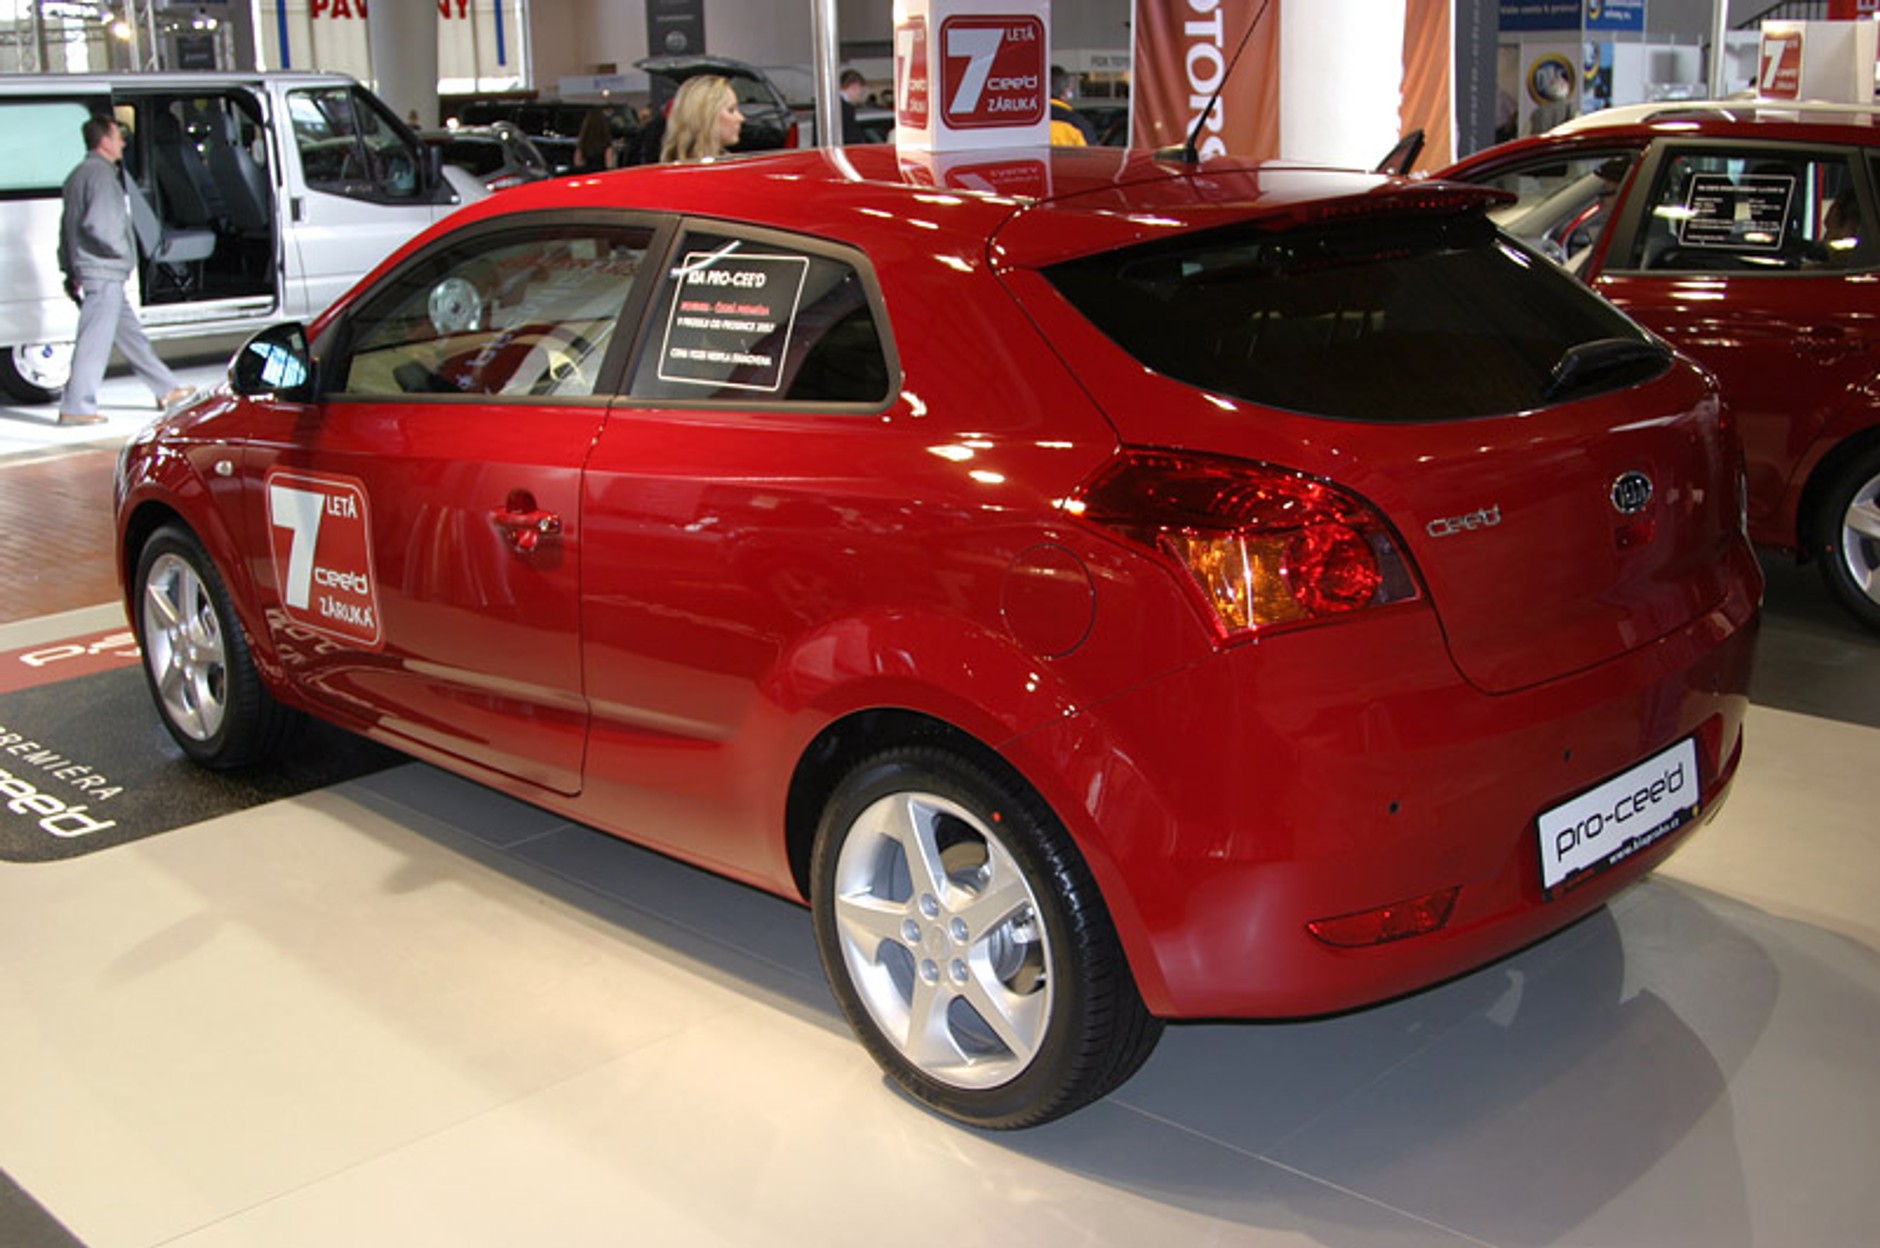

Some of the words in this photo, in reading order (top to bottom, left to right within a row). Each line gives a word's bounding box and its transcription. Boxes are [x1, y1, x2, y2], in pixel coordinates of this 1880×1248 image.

[948, 28, 1005, 113] 7
[1762, 40, 1787, 89] 7
[270, 485, 325, 610] 7
[326, 495, 358, 518] LETÁ
[0, 726, 124, 801] REMIÉRA
